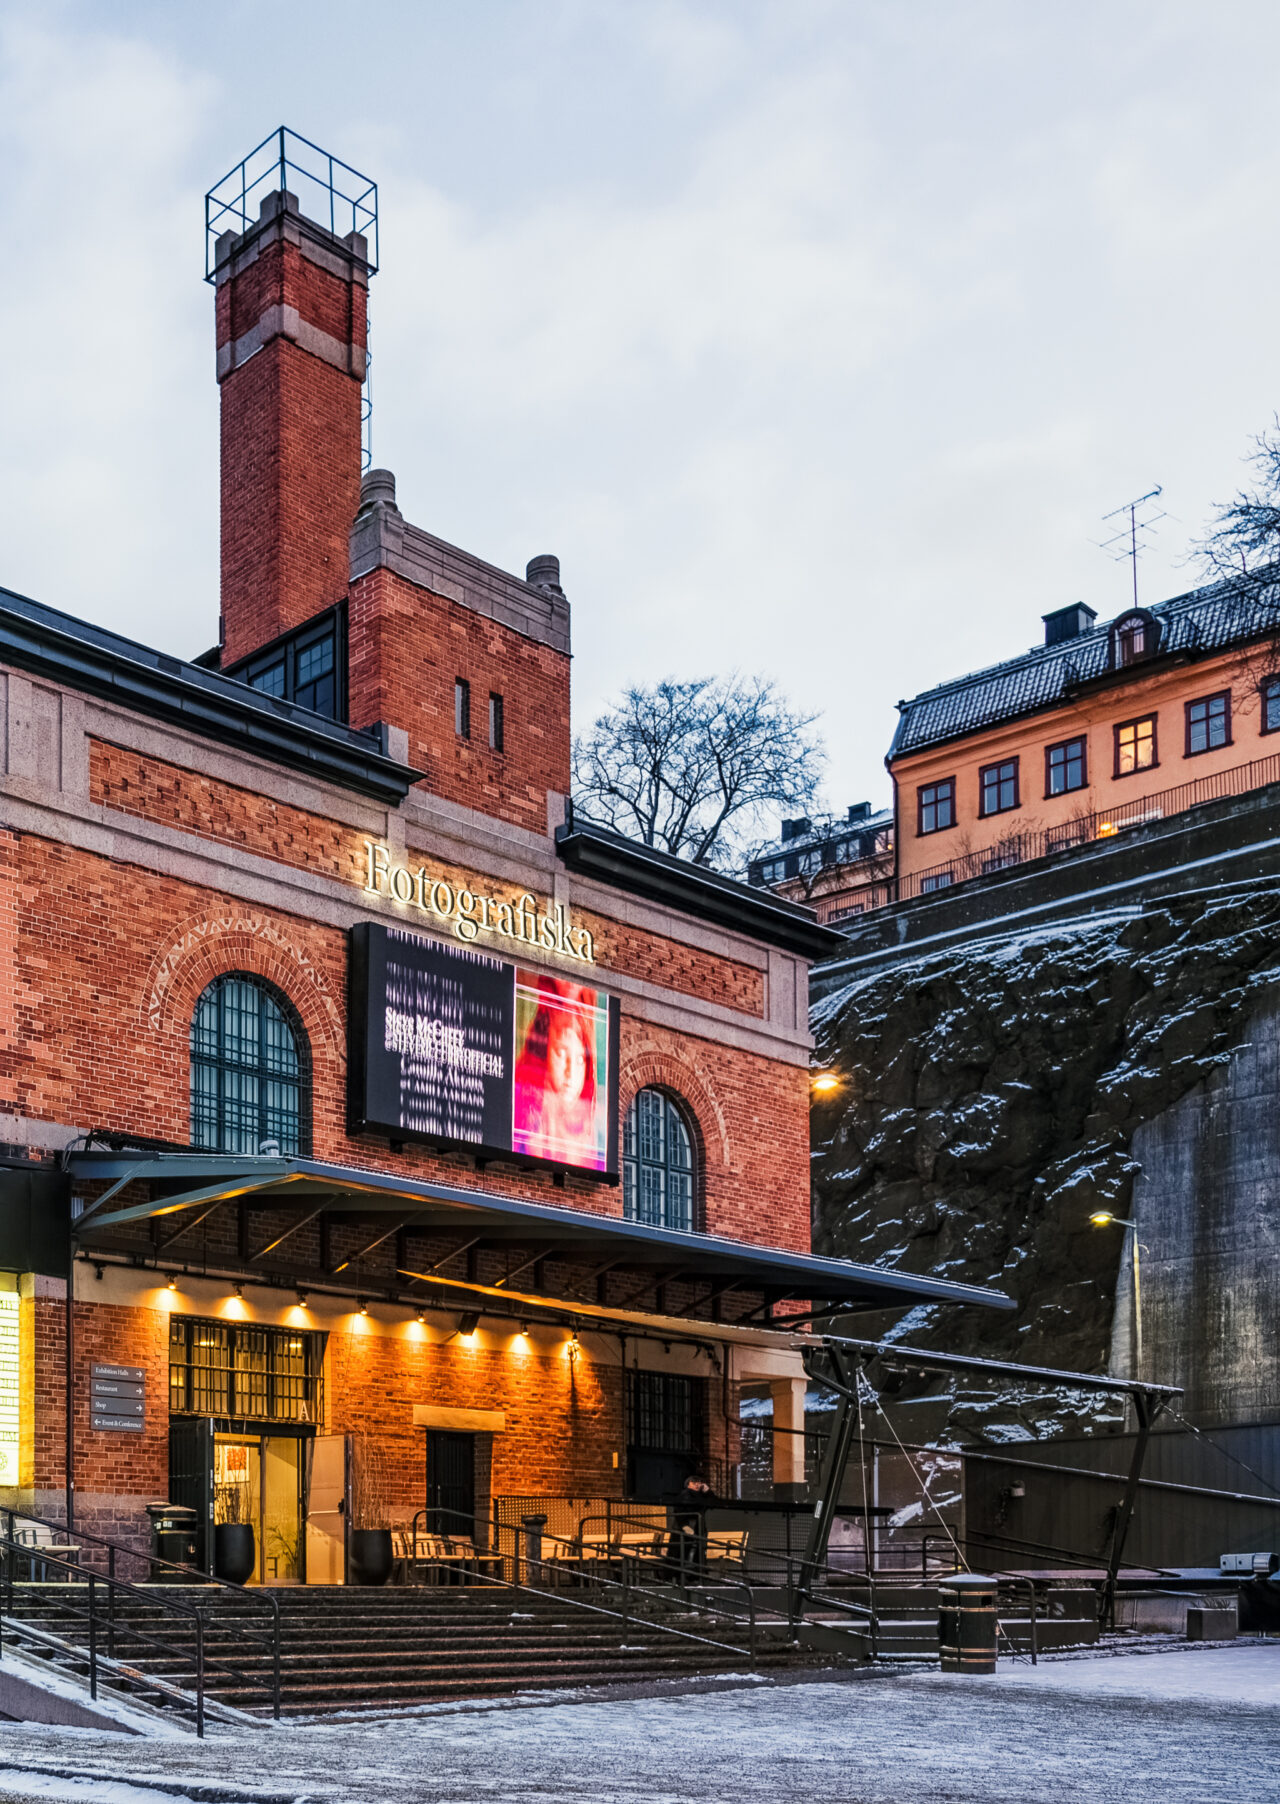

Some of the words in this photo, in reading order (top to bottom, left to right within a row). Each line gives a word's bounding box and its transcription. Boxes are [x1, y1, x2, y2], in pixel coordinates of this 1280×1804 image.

[363, 840, 594, 963] Fotografiska
[95, 1367, 118, 1375] Exhibition
[95, 1384, 118, 1392] Restaurant
[95, 1401, 107, 1410] Shop
[299, 1400, 310, 1421] A
